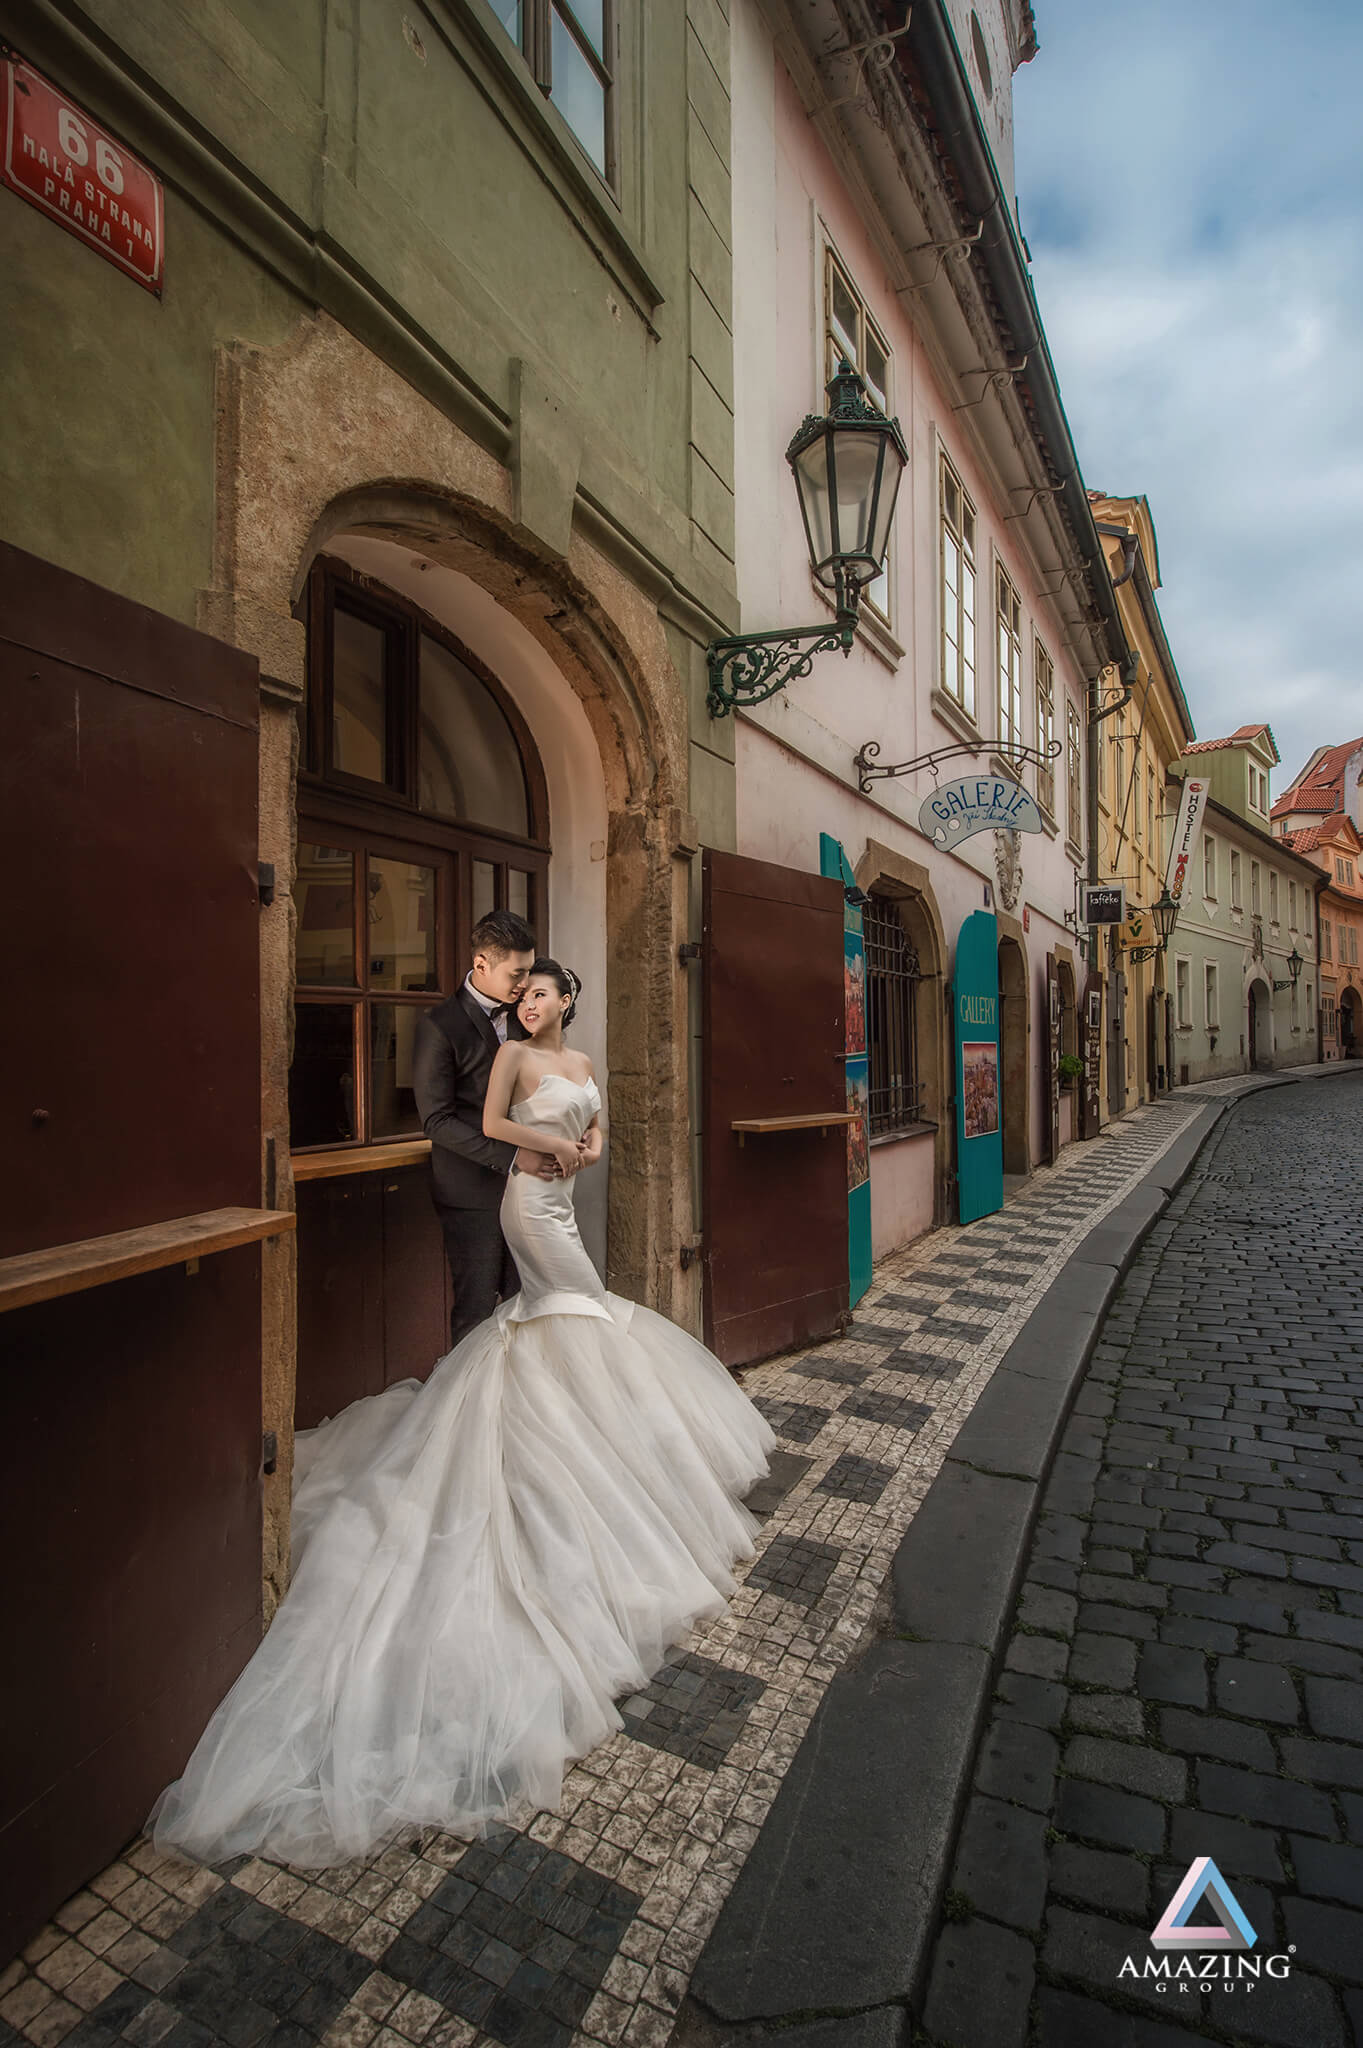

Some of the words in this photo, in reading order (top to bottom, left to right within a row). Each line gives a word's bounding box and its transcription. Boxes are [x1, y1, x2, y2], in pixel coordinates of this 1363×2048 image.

[58, 107, 124, 196] 66
[23, 132, 75, 188] MALÁ
[84, 180, 153, 251] STRANA
[44, 178, 112, 242] PRAHA
[126, 239, 134, 257] 1
[931, 782, 1030, 820] GALERIE
[1181, 794, 1199, 852] HOSTEL
[1170, 853, 1189, 901] MANGO
[960, 994, 996, 1025] GALLERY
